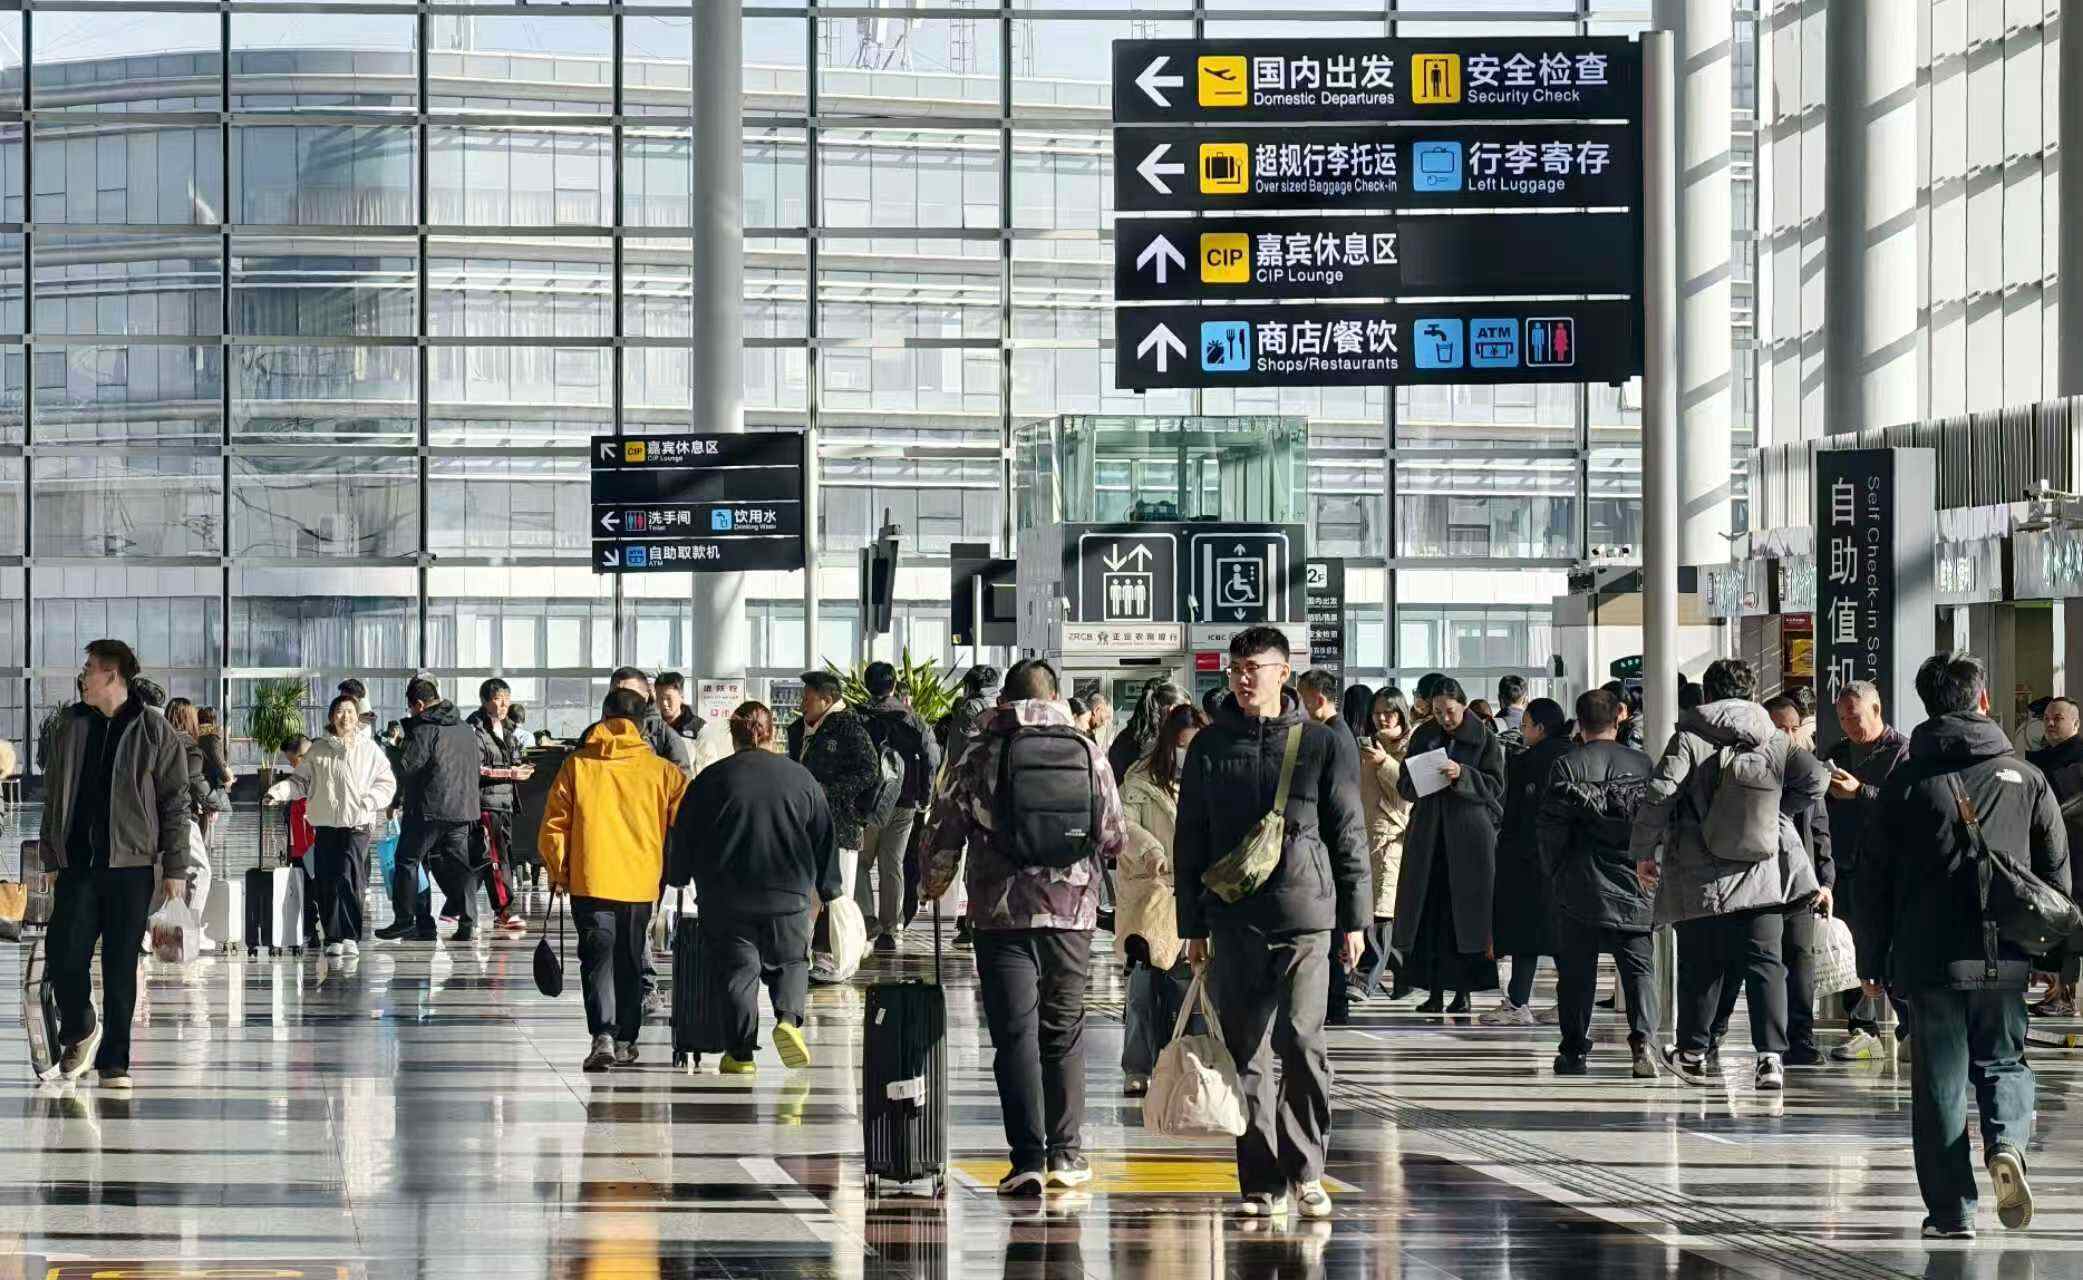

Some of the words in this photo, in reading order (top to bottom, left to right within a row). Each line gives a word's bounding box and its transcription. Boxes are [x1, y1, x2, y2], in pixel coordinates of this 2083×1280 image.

[1253, 54, 1394, 90] 国内出发
[1467, 52, 1608, 87] 安全检查
[1254, 91, 1316, 106] Domestic
[1321, 90, 1395, 107] Departures
[1468, 89, 1529, 105] Security
[1533, 88, 1580, 102] Check
[1255, 142, 1397, 177] 超规行李托运
[1469, 141, 1610, 175] 行李寄存
[1255, 179, 1279, 193] Over
[1309, 179, 1352, 195] Baggage
[1354, 178, 1398, 192] Check-in
[1468, 177, 1497, 191] Left
[1501, 178, 1565, 194] Luggage
[1207, 248, 1243, 266] CIP
[1256, 232, 1398, 266] 嘉宾休息区
[1256, 268, 1284, 283] CIP
[1288, 268, 1344, 285] Lounge
[1256, 319, 1398, 354] 商店/餐饮
[1477, 327, 1511, 338] ATM
[1257, 356, 1399, 373] Shops/Restaurants
[1868, 475, 1880, 521] Self
[649, 511, 691, 525] 洗手间
[734, 509, 777, 523] 饮用水
[649, 545, 720, 560] 自助取款机
[1867, 527, 1880, 629] Check-in
[1827, 477, 1858, 704] 自助值机
